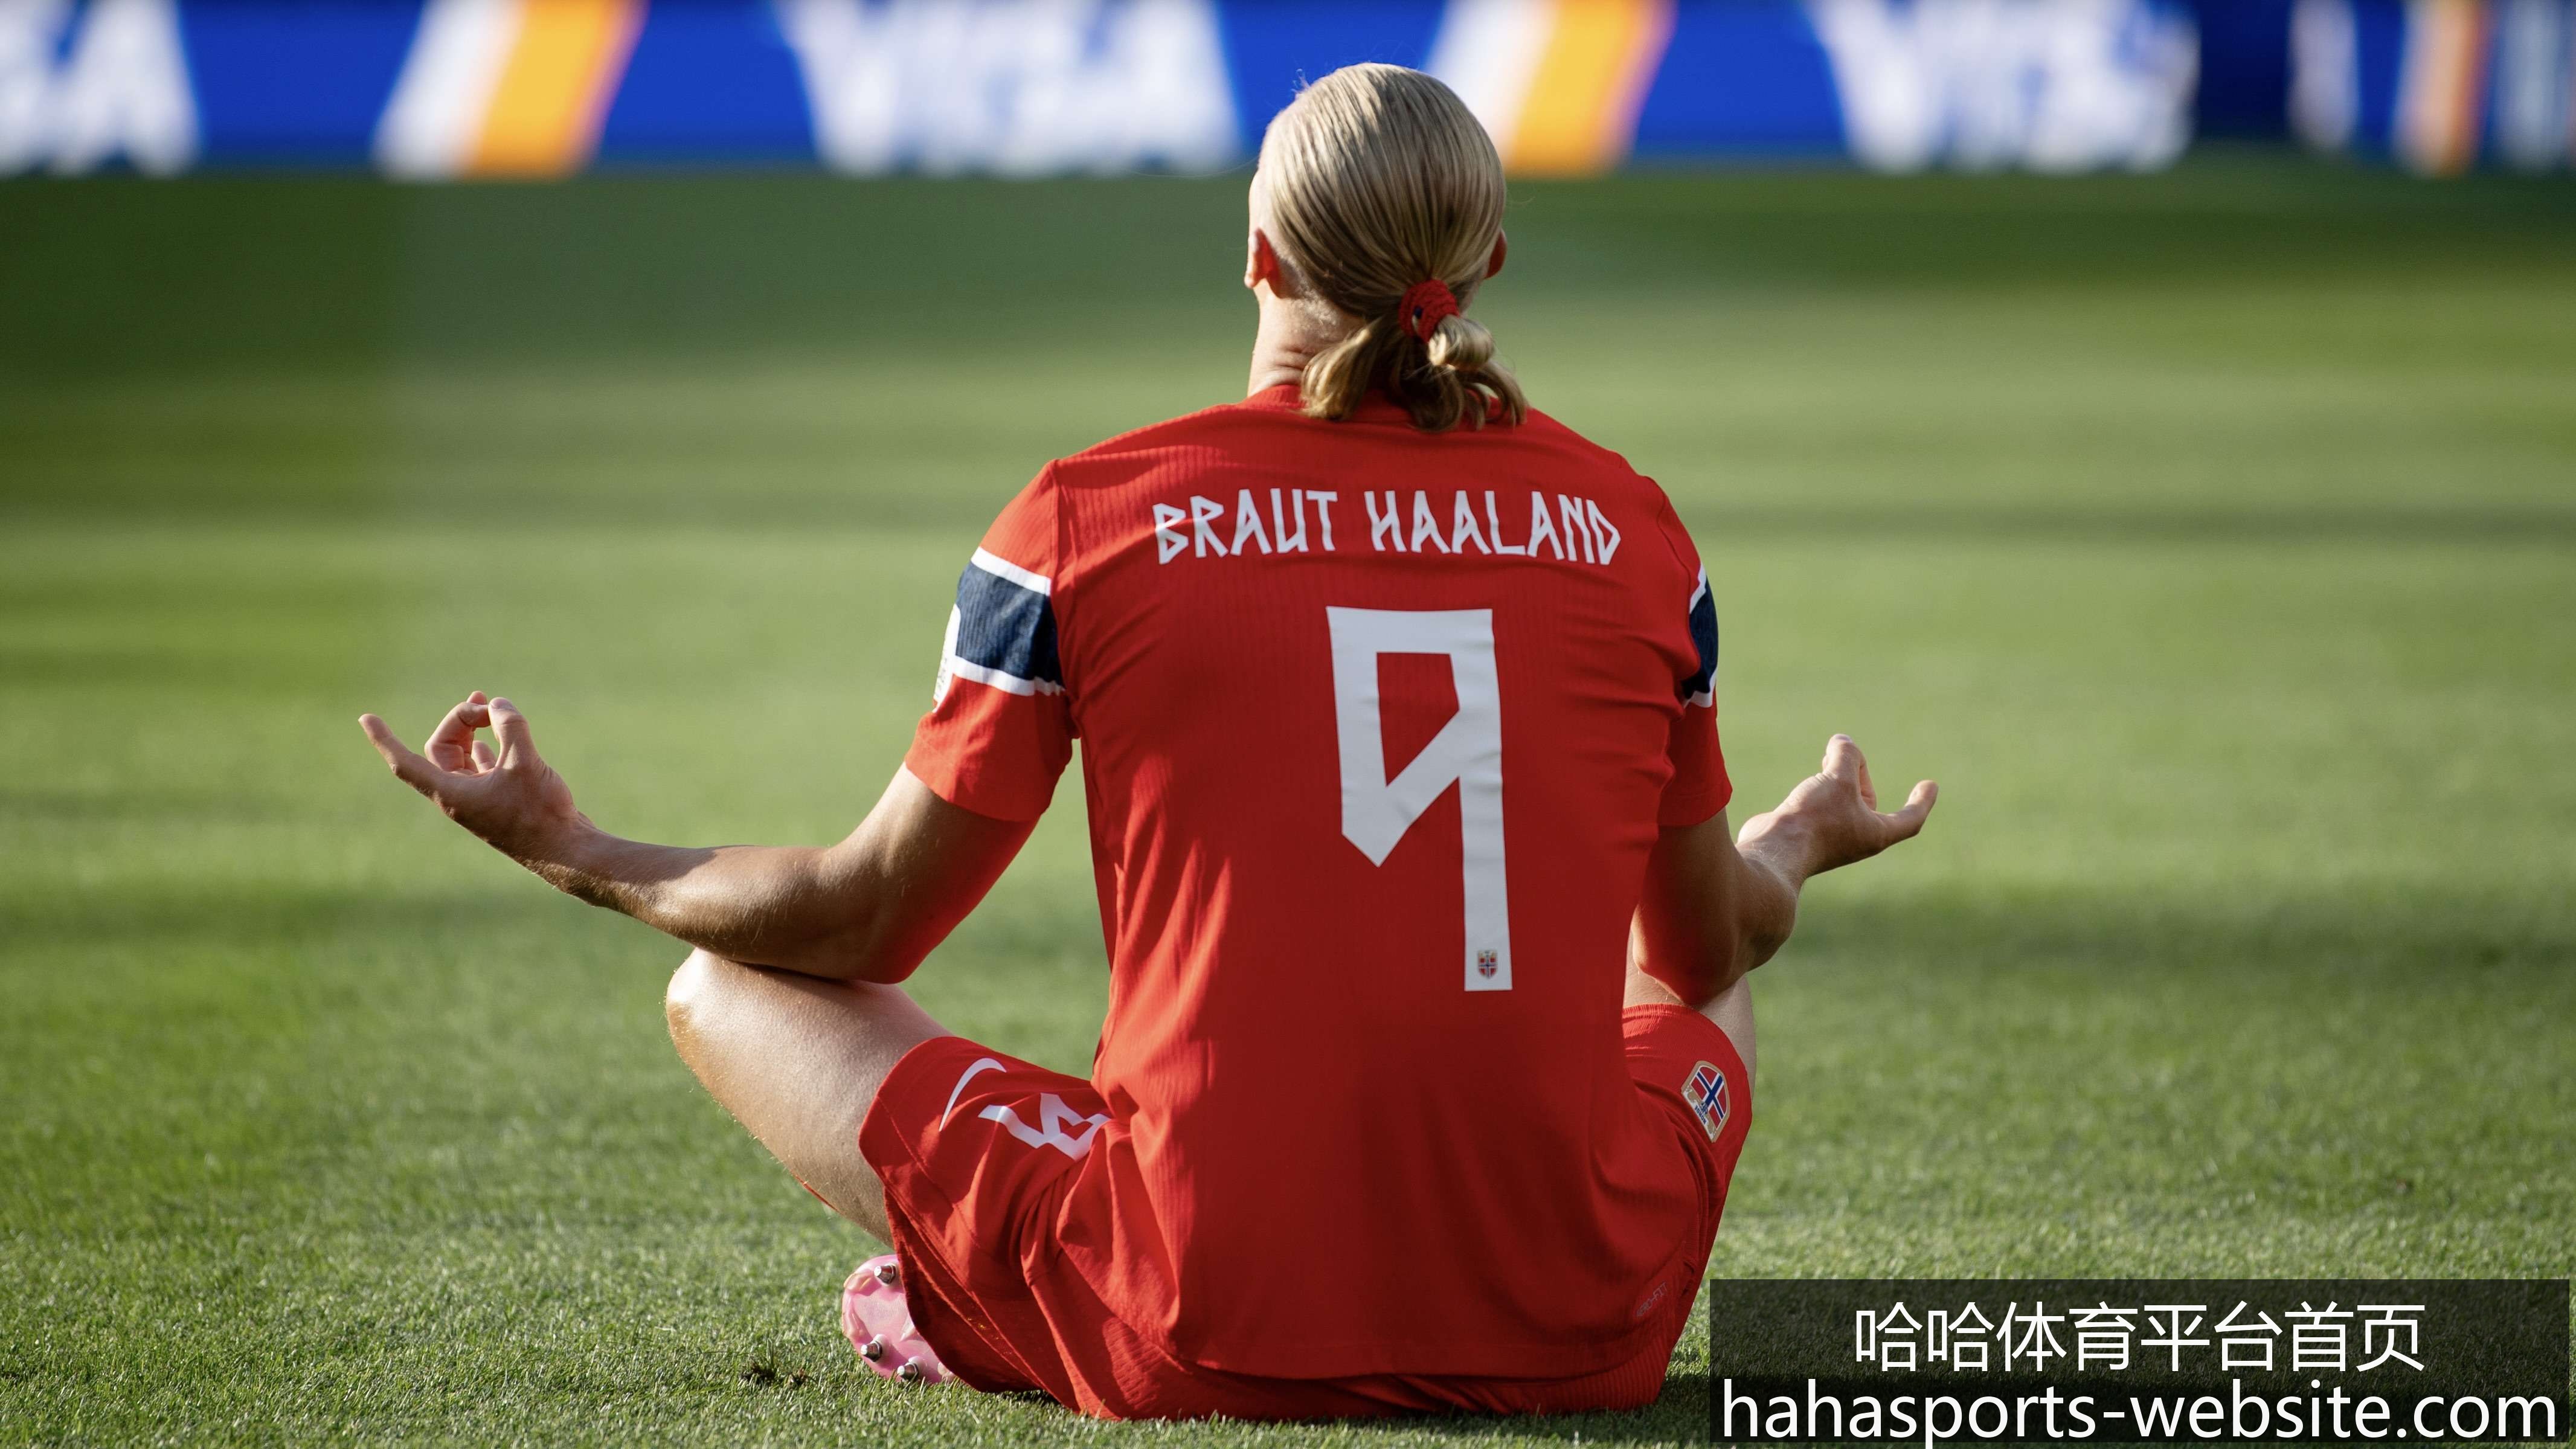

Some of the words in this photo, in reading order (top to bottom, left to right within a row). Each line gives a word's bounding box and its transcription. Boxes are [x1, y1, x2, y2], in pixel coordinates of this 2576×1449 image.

[1152, 488, 1338, 564] BRAUT
[1364, 490, 1621, 565] HAALAND
[1326, 606, 1512, 991] 9
